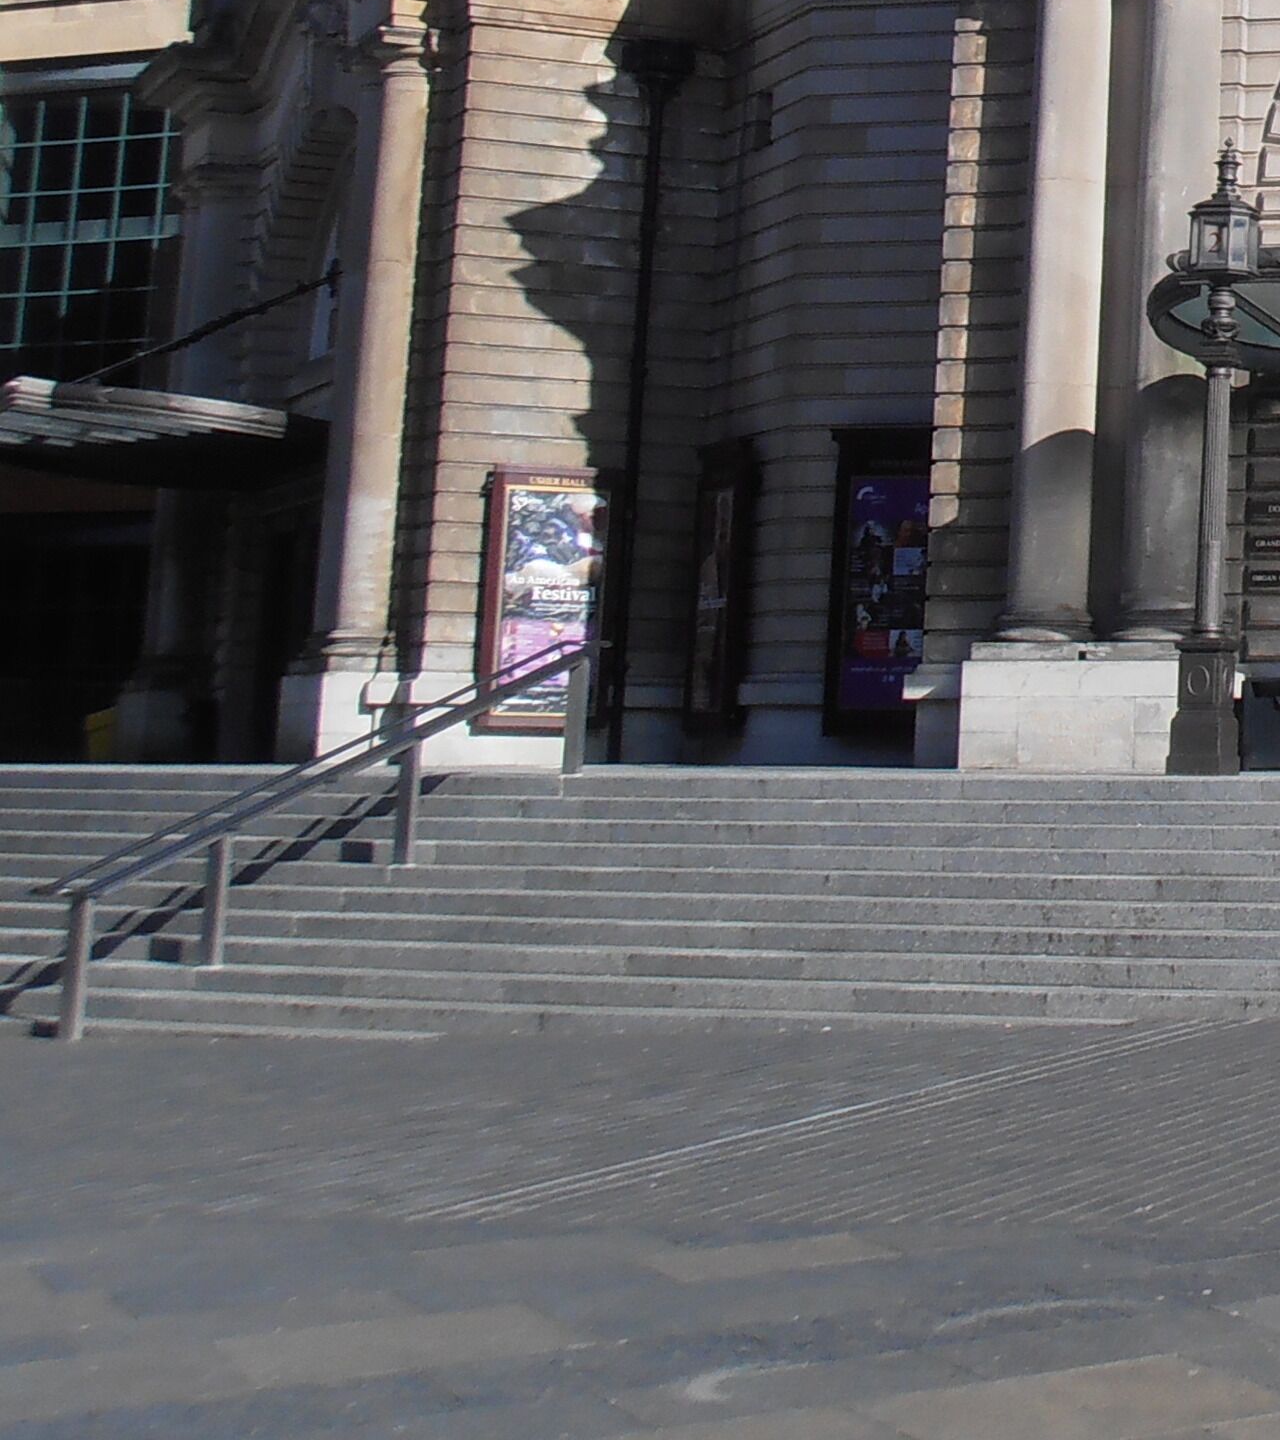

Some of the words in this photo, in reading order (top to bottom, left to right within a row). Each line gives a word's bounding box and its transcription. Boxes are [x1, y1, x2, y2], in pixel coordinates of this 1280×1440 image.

[529, 476, 561, 485] USHER
[562, 478, 586, 486] HALL
[510, 575, 525, 584] An
[527, 575, 580, 586] American
[1252, 574, 1277, 582] ORGAN
[531, 587, 596, 601] Festival
